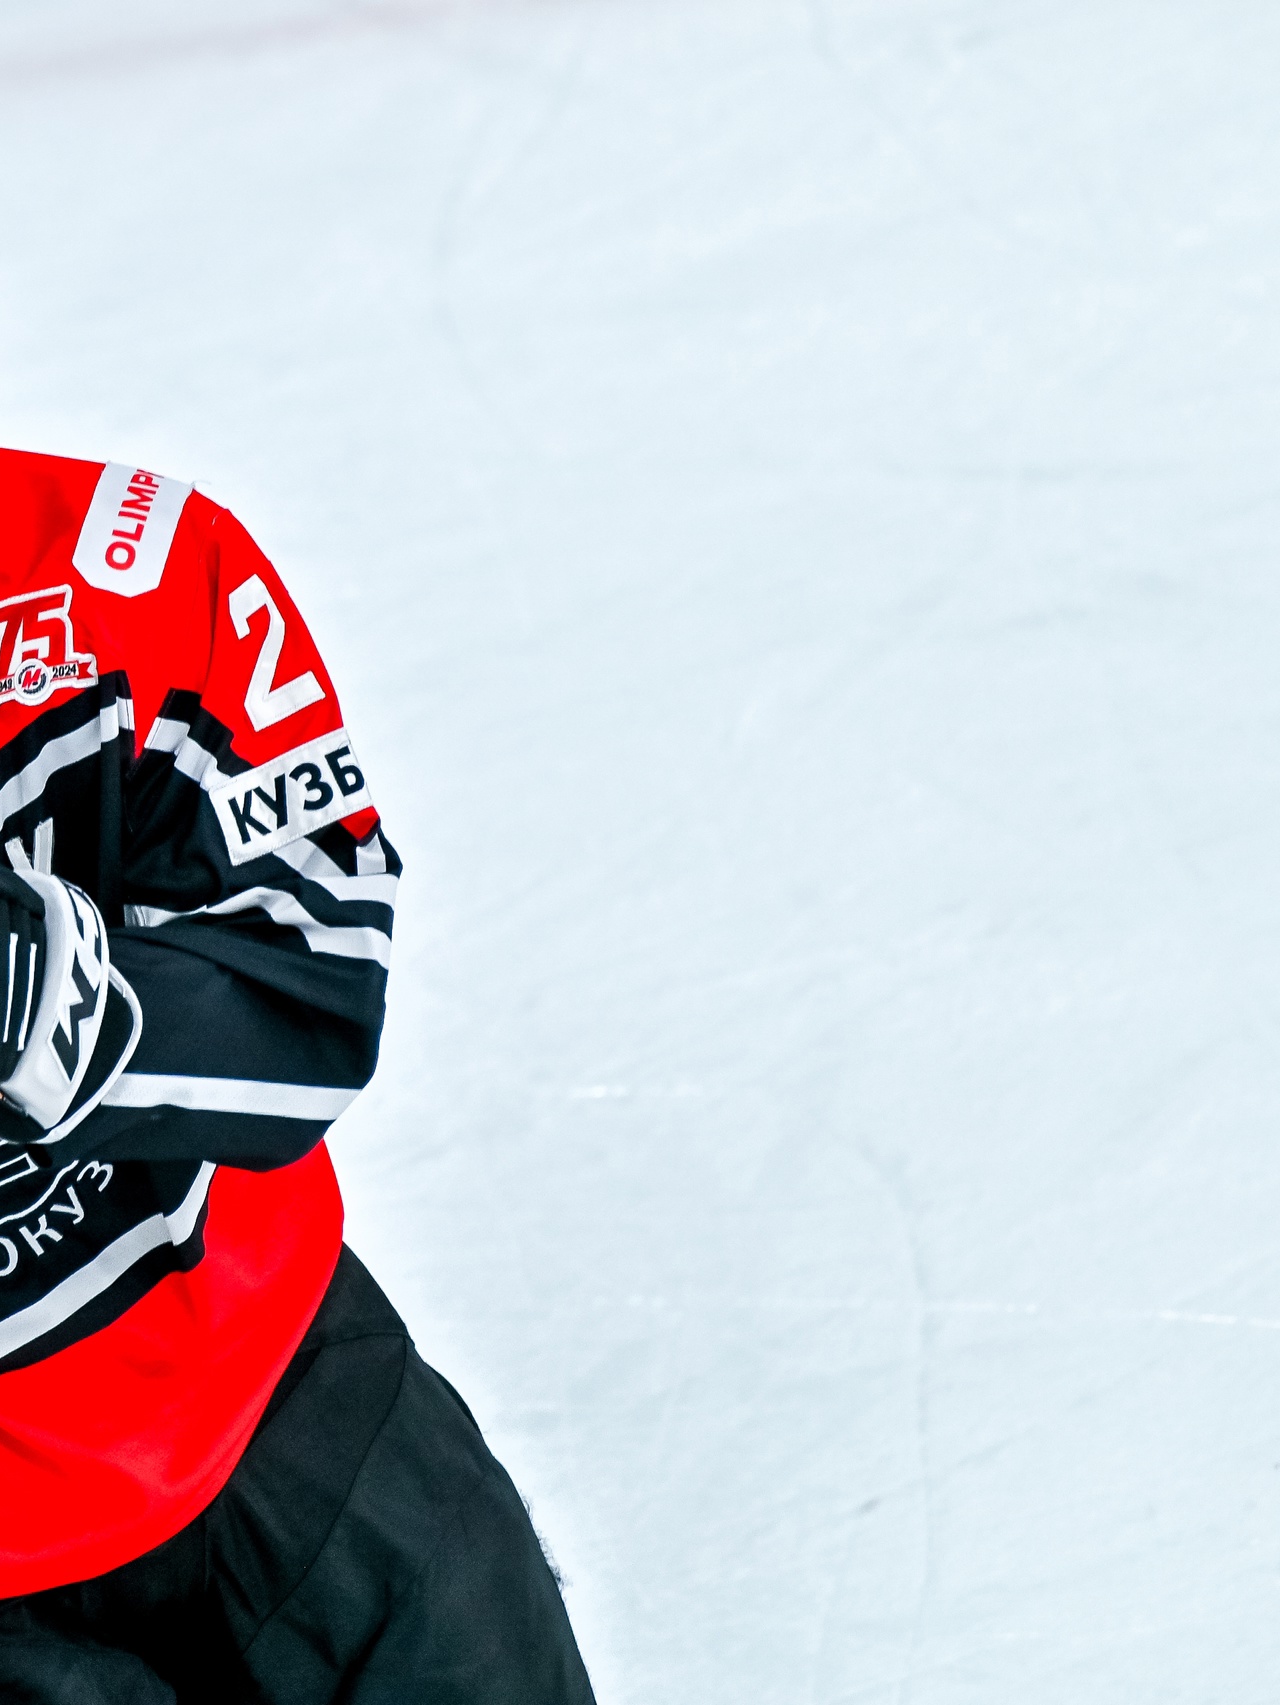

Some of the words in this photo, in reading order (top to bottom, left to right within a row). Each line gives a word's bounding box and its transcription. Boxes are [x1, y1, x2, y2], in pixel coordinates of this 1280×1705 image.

[104, 468, 165, 571] OLIMP
[52, 664, 77, 678] 2024
[228, 573, 326, 732] 2
[228, 745, 365, 845] КУЗБ
